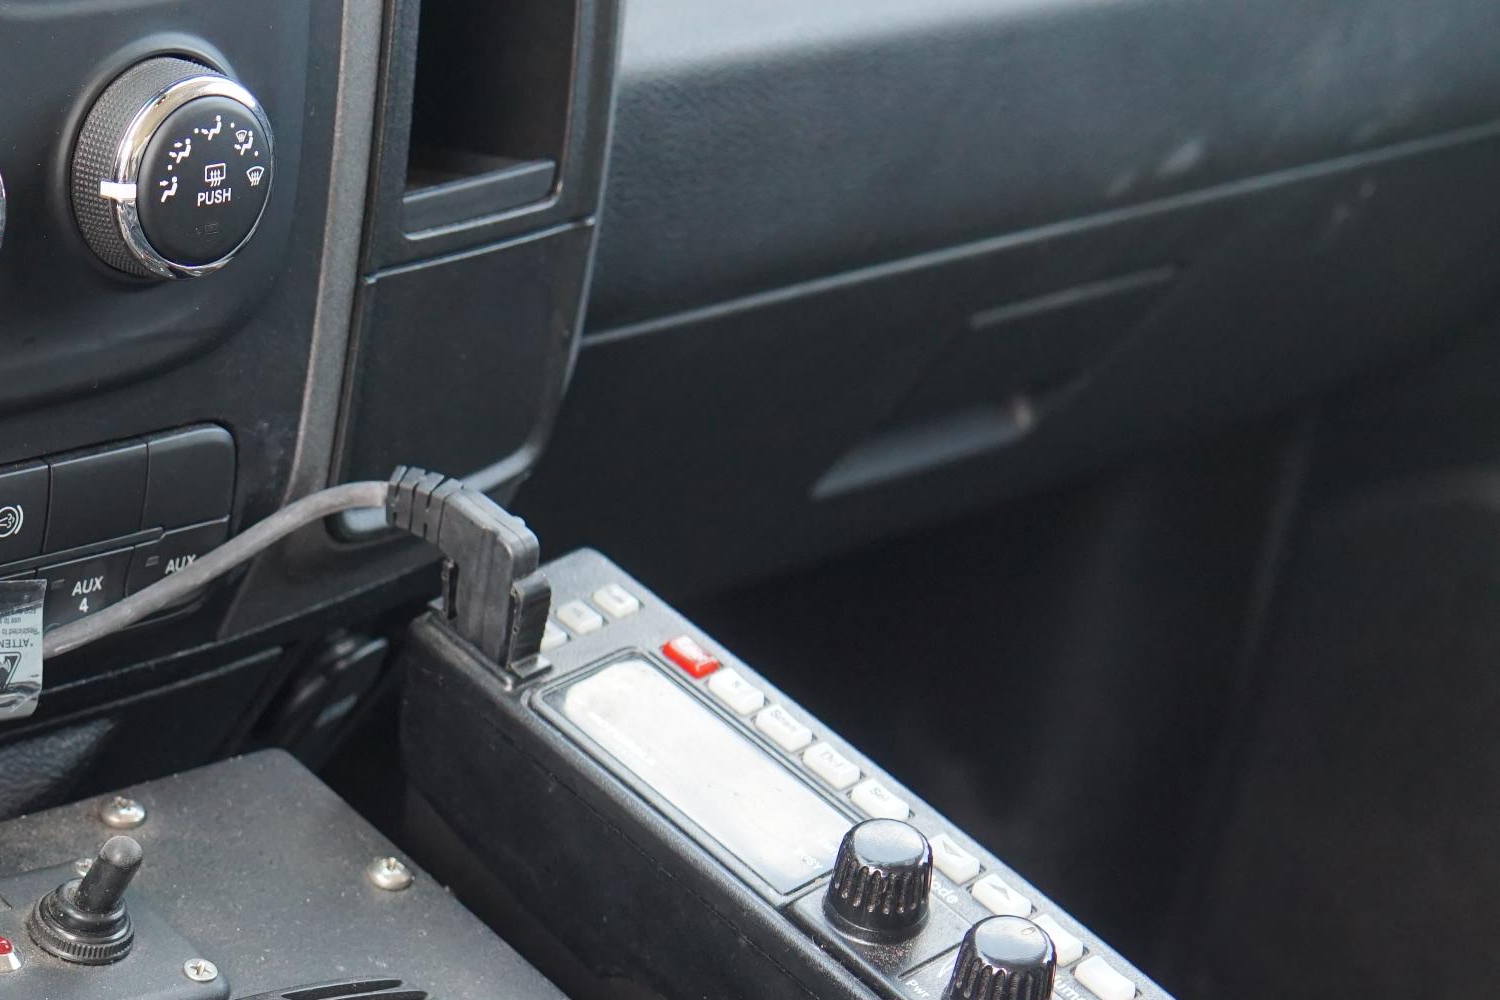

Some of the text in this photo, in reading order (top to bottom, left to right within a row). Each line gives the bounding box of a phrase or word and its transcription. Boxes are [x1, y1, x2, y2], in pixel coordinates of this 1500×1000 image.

[197, 187, 232, 207] PUSH
[164, 554, 197, 575] AUX
[71, 576, 104, 597] AUX
[78, 597, 89, 613] 4
[905, 979, 930, 999] Pwr
